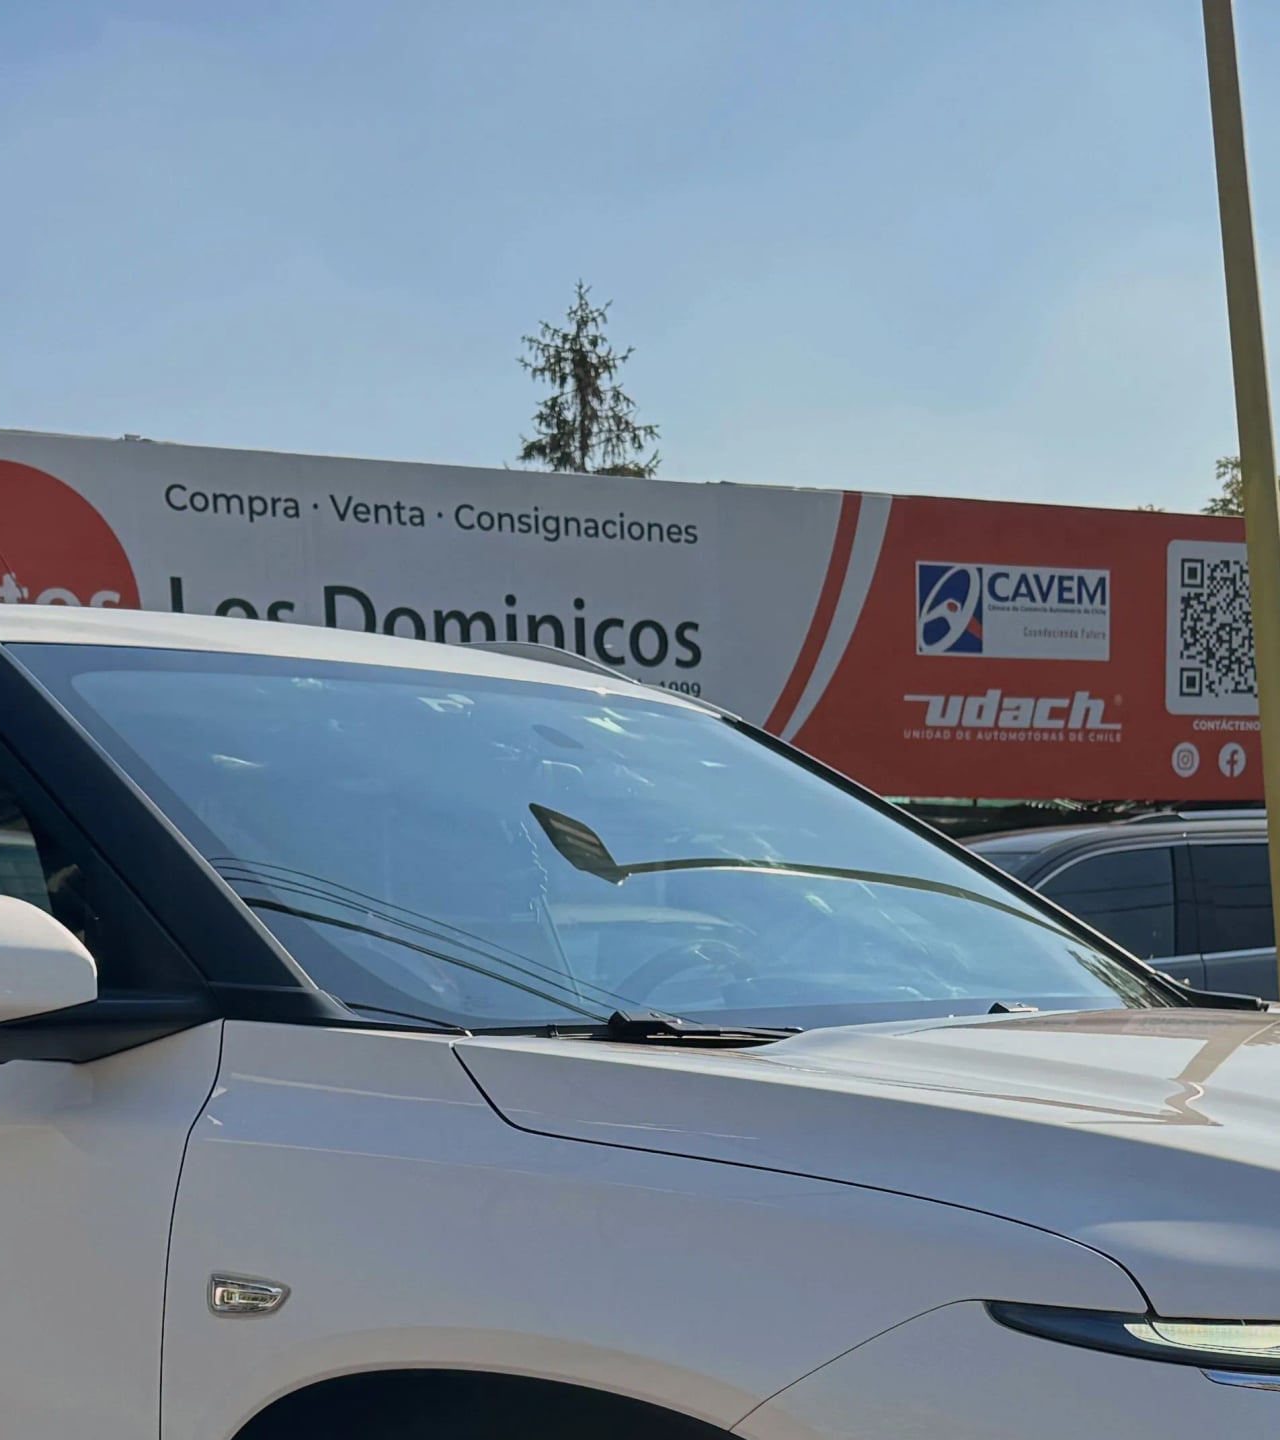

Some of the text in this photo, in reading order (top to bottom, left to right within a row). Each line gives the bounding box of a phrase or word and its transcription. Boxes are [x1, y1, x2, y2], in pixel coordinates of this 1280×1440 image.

[164, 483, 699, 545] Compra Venta Consignaciones
[987, 571, 1107, 606] CAVEM
[903, 688, 1123, 731] udach
[1192, 717, 1262, 731] CONTÁCTENO
[903, 728, 1123, 743] UNIDAD DE AUTOMOTORAS DE CHILE
